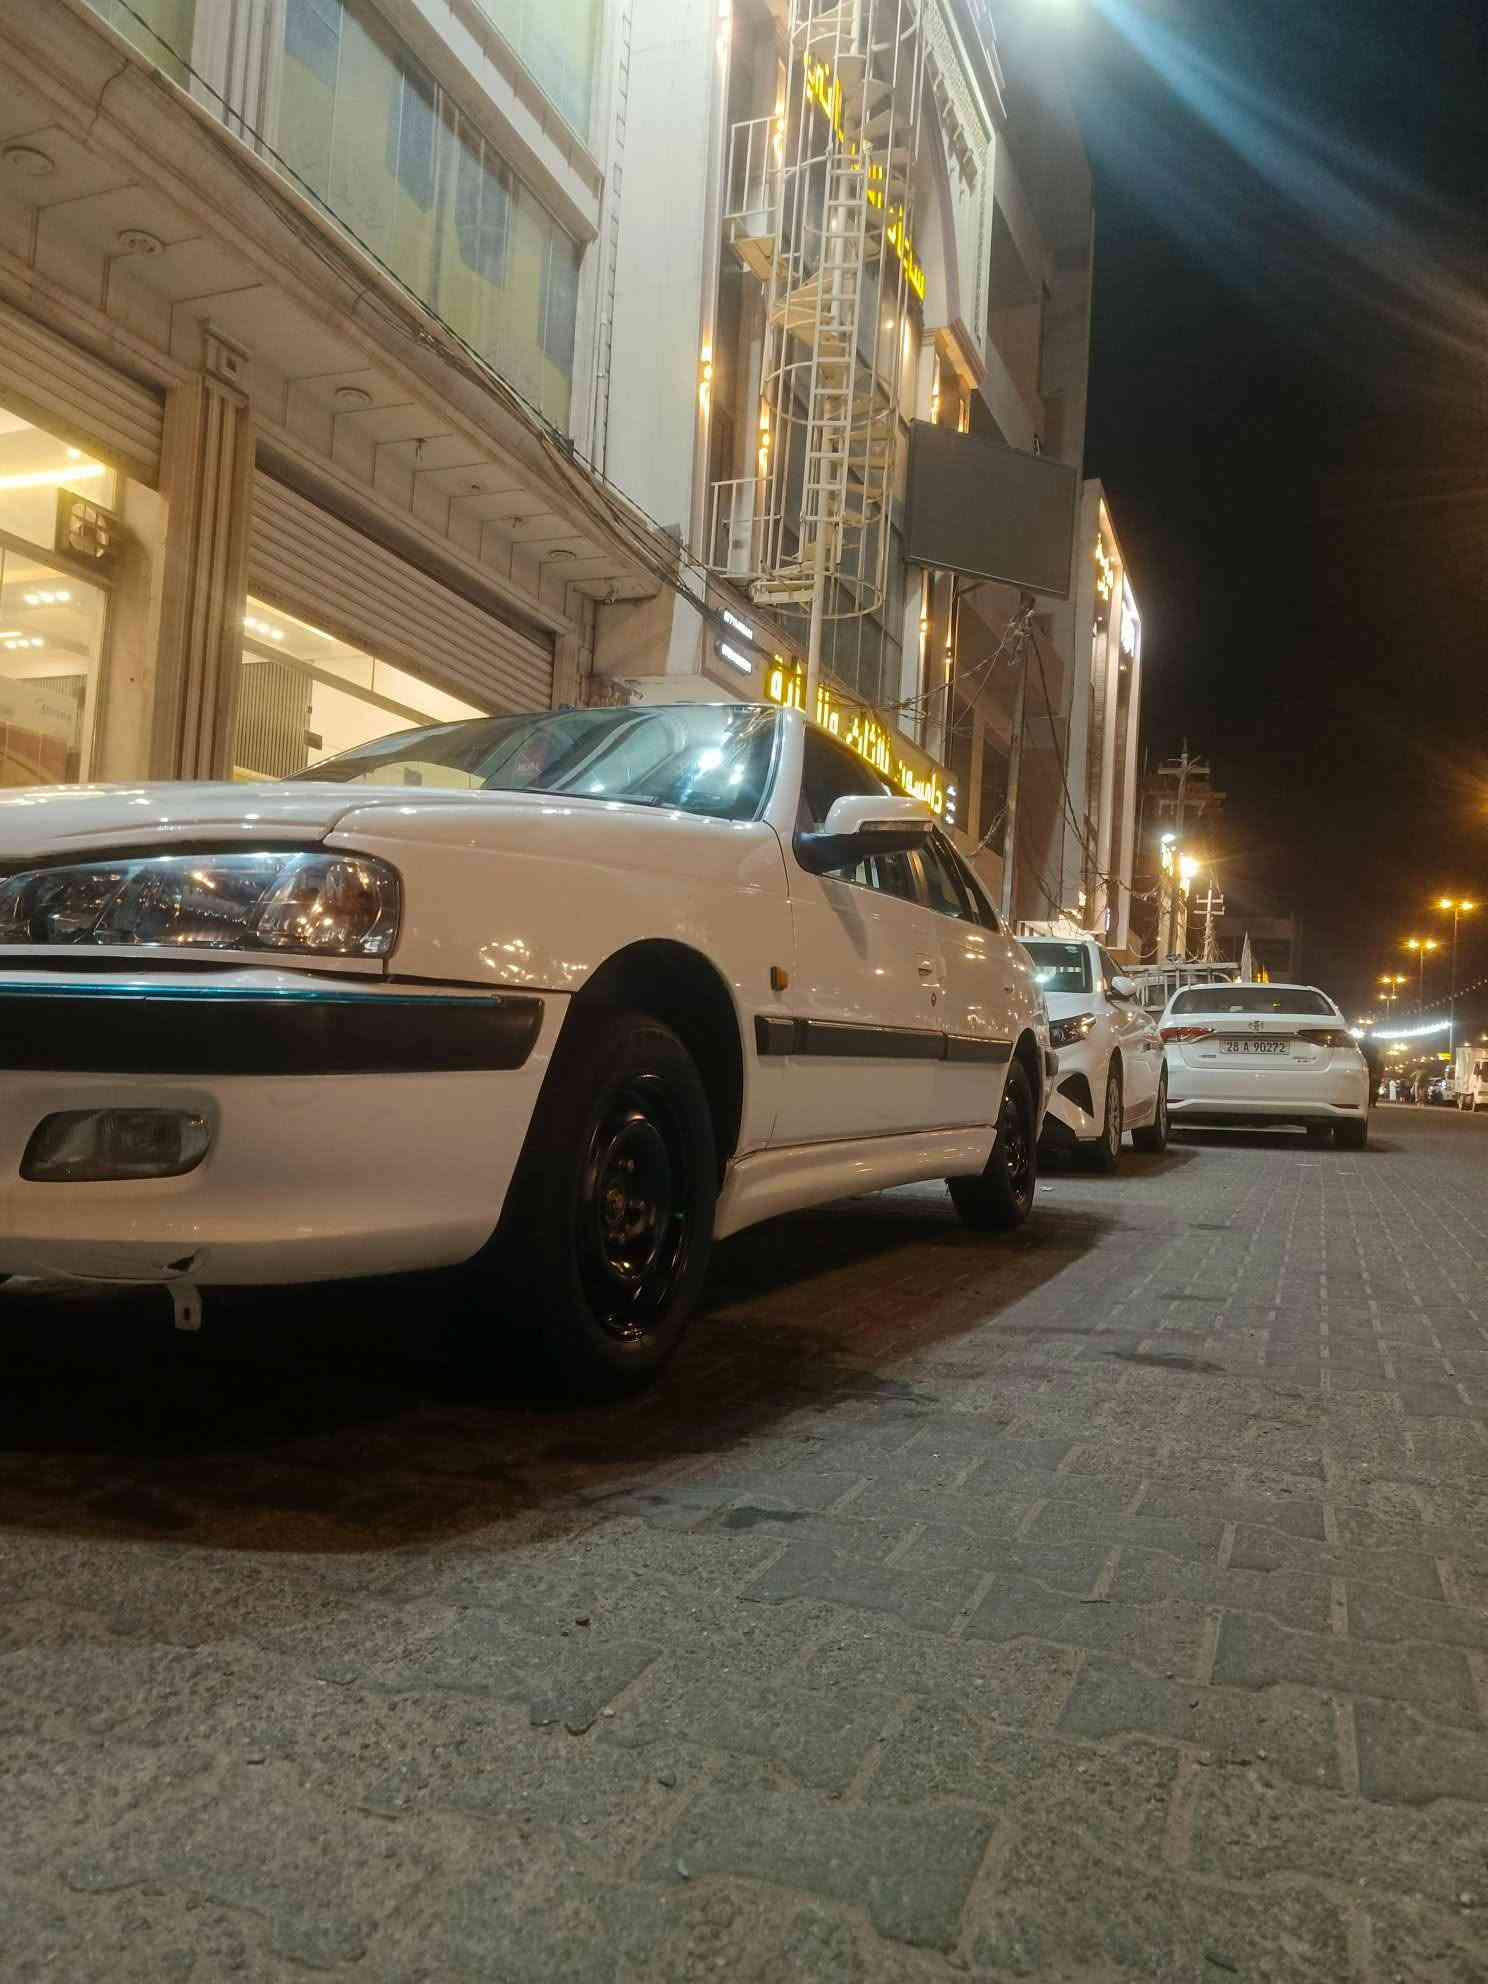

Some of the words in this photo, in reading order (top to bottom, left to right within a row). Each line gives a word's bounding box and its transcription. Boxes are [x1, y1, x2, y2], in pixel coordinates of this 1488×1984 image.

[1225, 1041, 1239, 1052] 28
[1243, 1041, 1249, 1051] A
[1253, 1041, 1286, 1053] 90272
